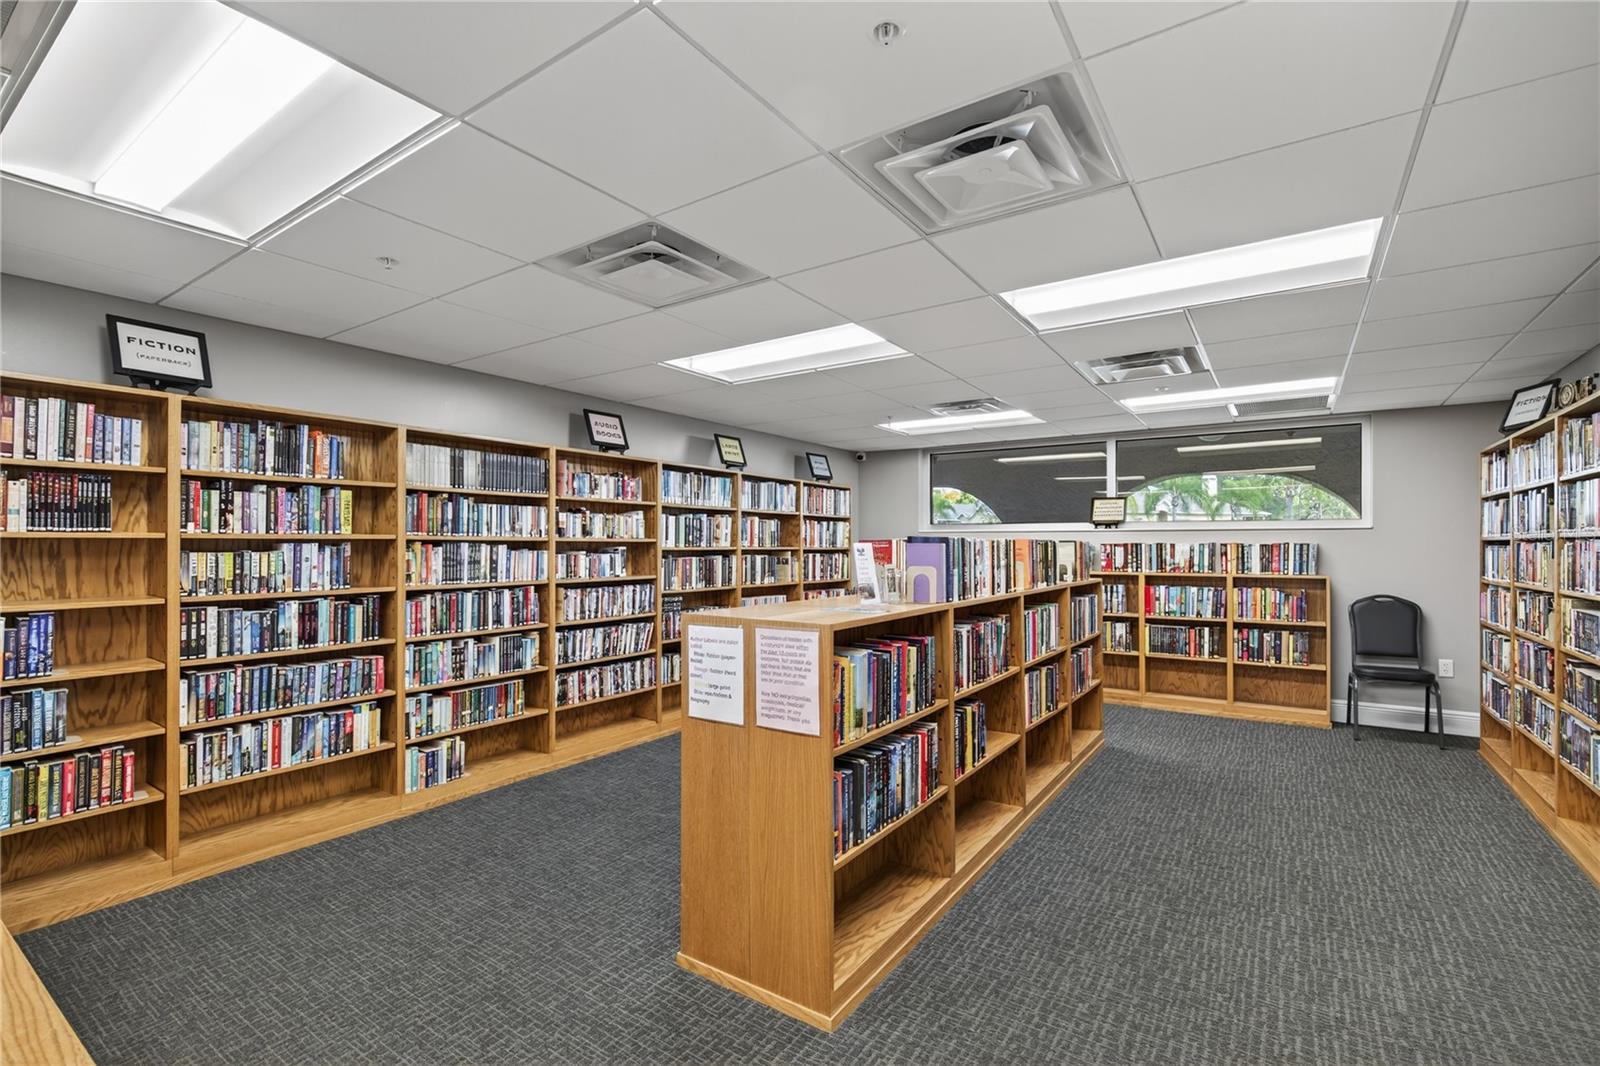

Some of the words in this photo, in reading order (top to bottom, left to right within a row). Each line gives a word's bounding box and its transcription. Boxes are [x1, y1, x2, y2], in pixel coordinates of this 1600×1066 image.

[126, 336, 196, 355] FICTION
[136, 352, 192, 368] (PAPERBACK)
[594, 421, 618, 430] AUDIO
[596, 430, 622, 438] BOOKS
